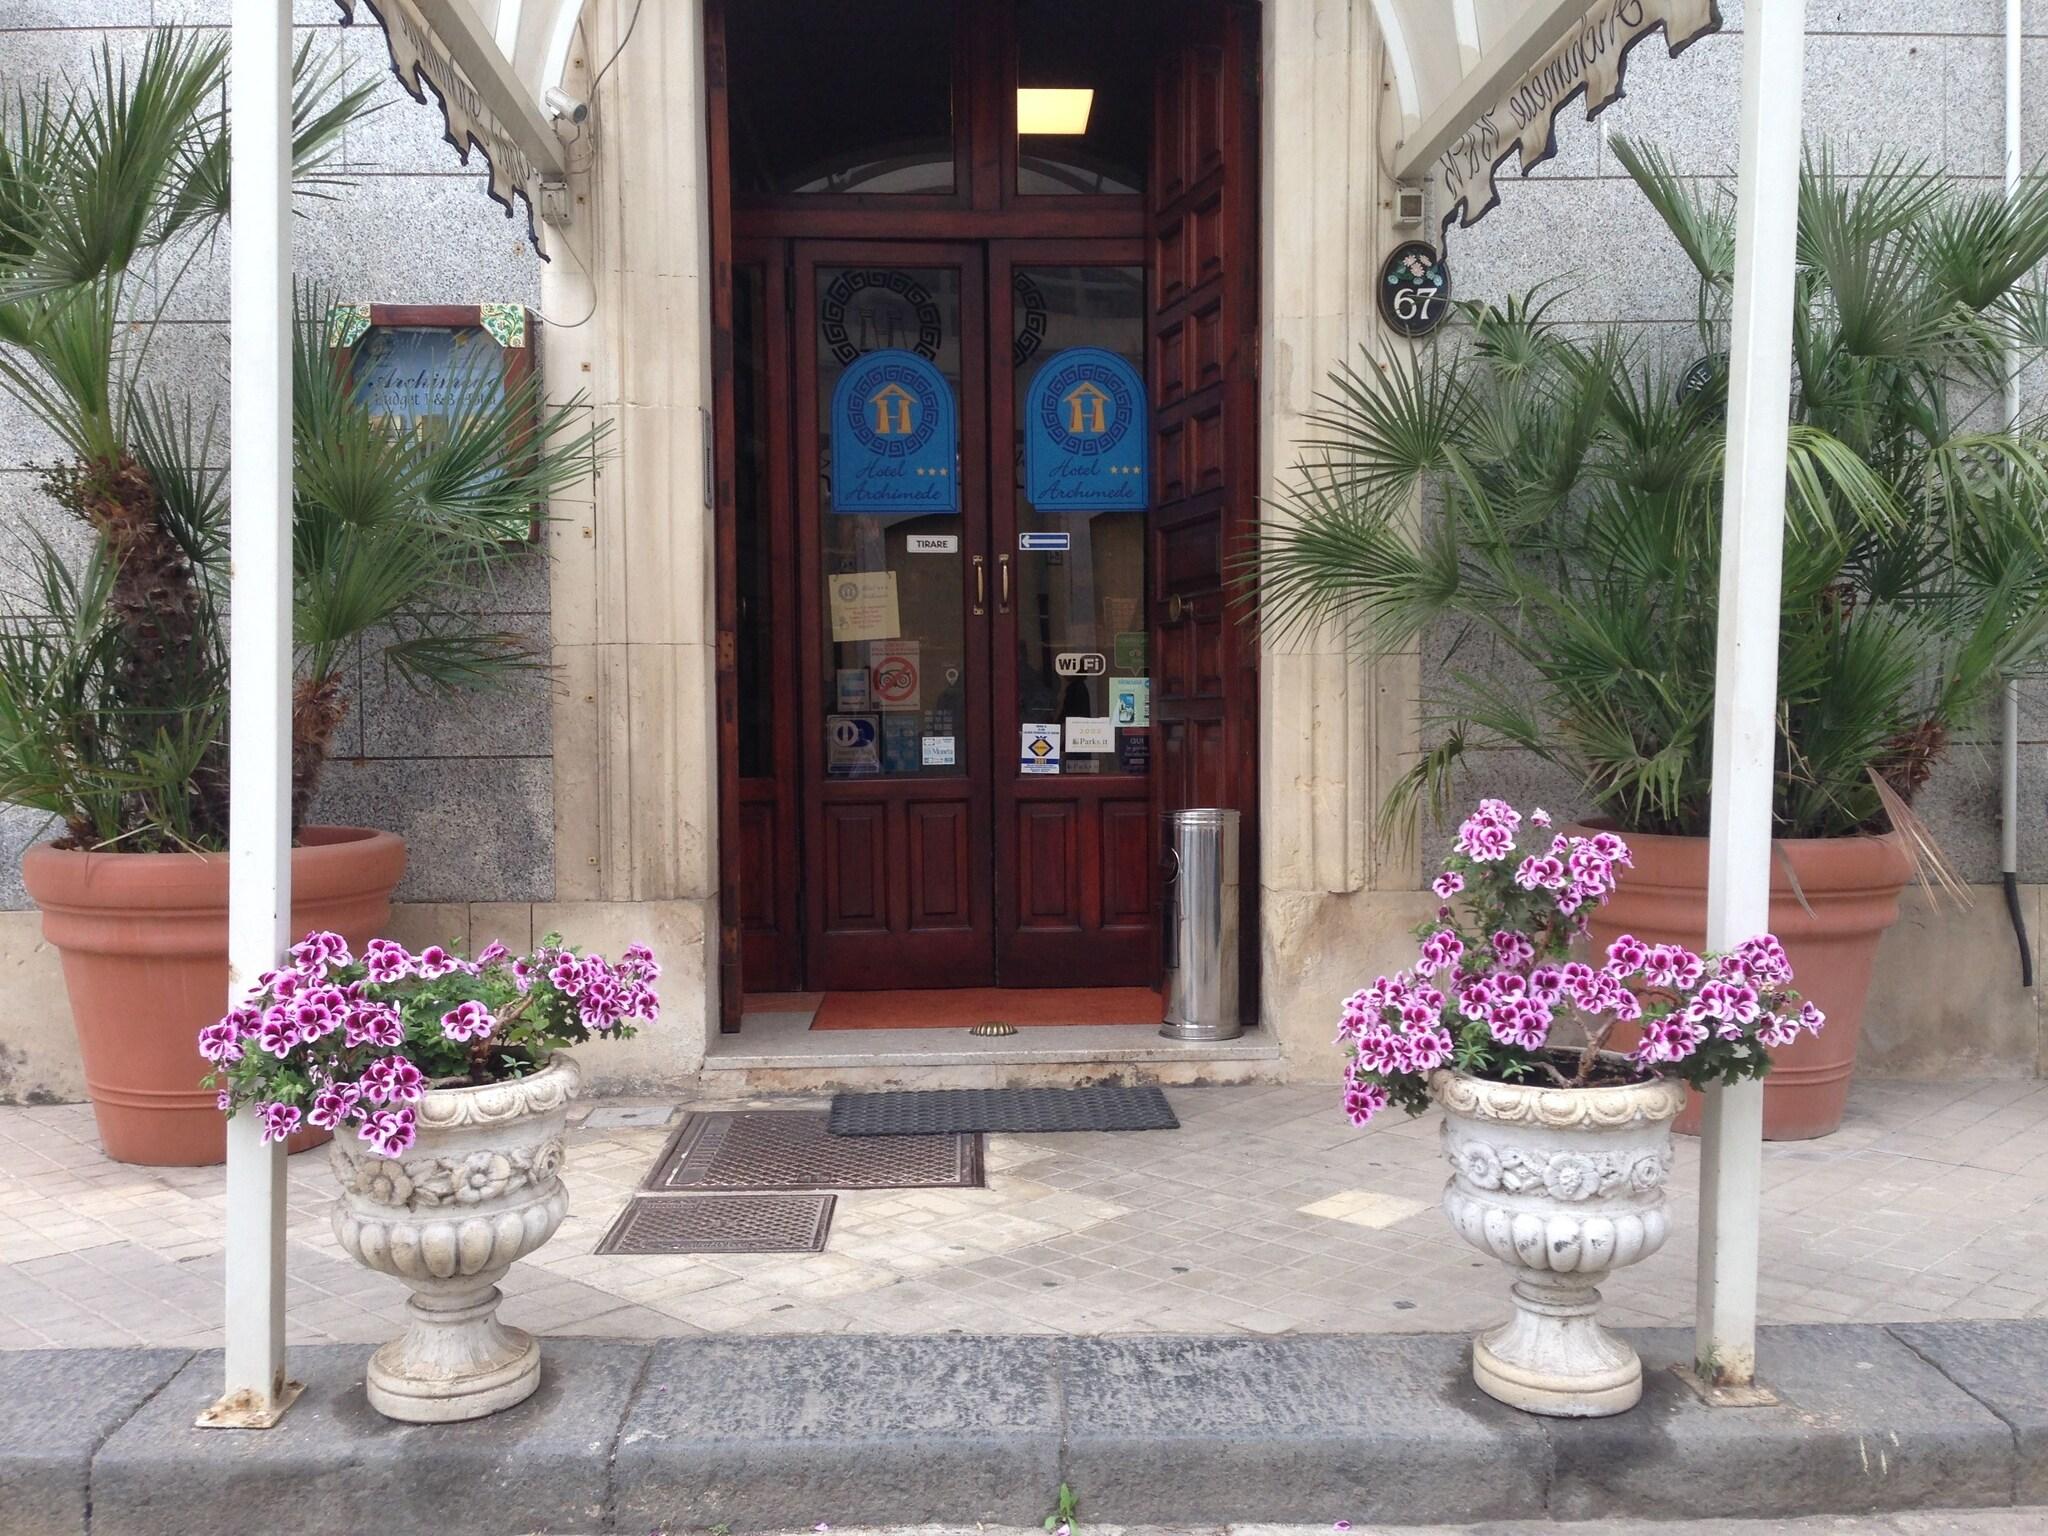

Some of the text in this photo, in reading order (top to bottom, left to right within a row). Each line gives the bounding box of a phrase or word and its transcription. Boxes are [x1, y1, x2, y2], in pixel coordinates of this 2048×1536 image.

[1394, 287, 1437, 320] 67
[433, 392, 443, 406] &
[856, 458, 907, 479] Hotel
[1049, 457, 1101, 478] Hotel
[845, 481, 942, 501] Archimede
[1038, 480, 1136, 500] Archimede
[916, 540, 948, 549] TIRARE
